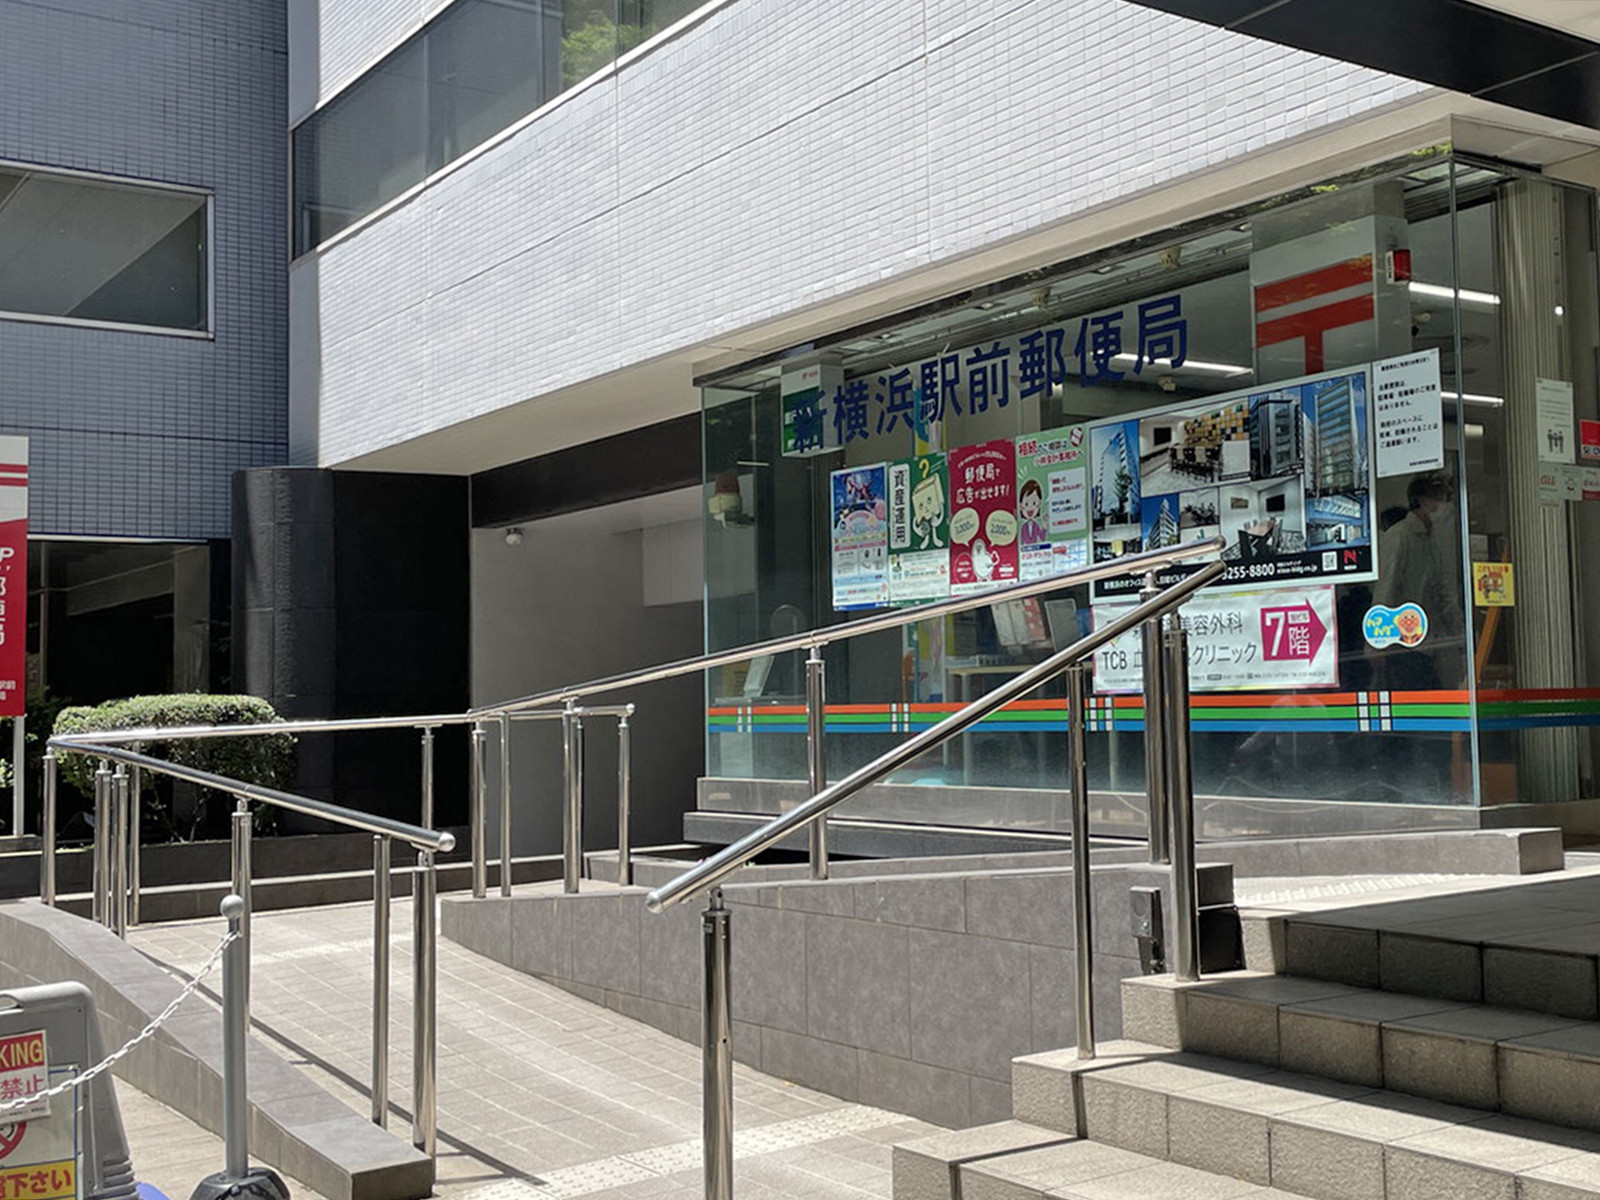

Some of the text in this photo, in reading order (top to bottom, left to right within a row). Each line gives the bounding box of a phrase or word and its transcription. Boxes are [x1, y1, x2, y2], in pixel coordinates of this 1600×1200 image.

[794, 294, 1188, 453] 新横浜駅前郵便局
[893, 470, 906, 544] 資産運用
[1102, 650, 1128, 671] TCB
